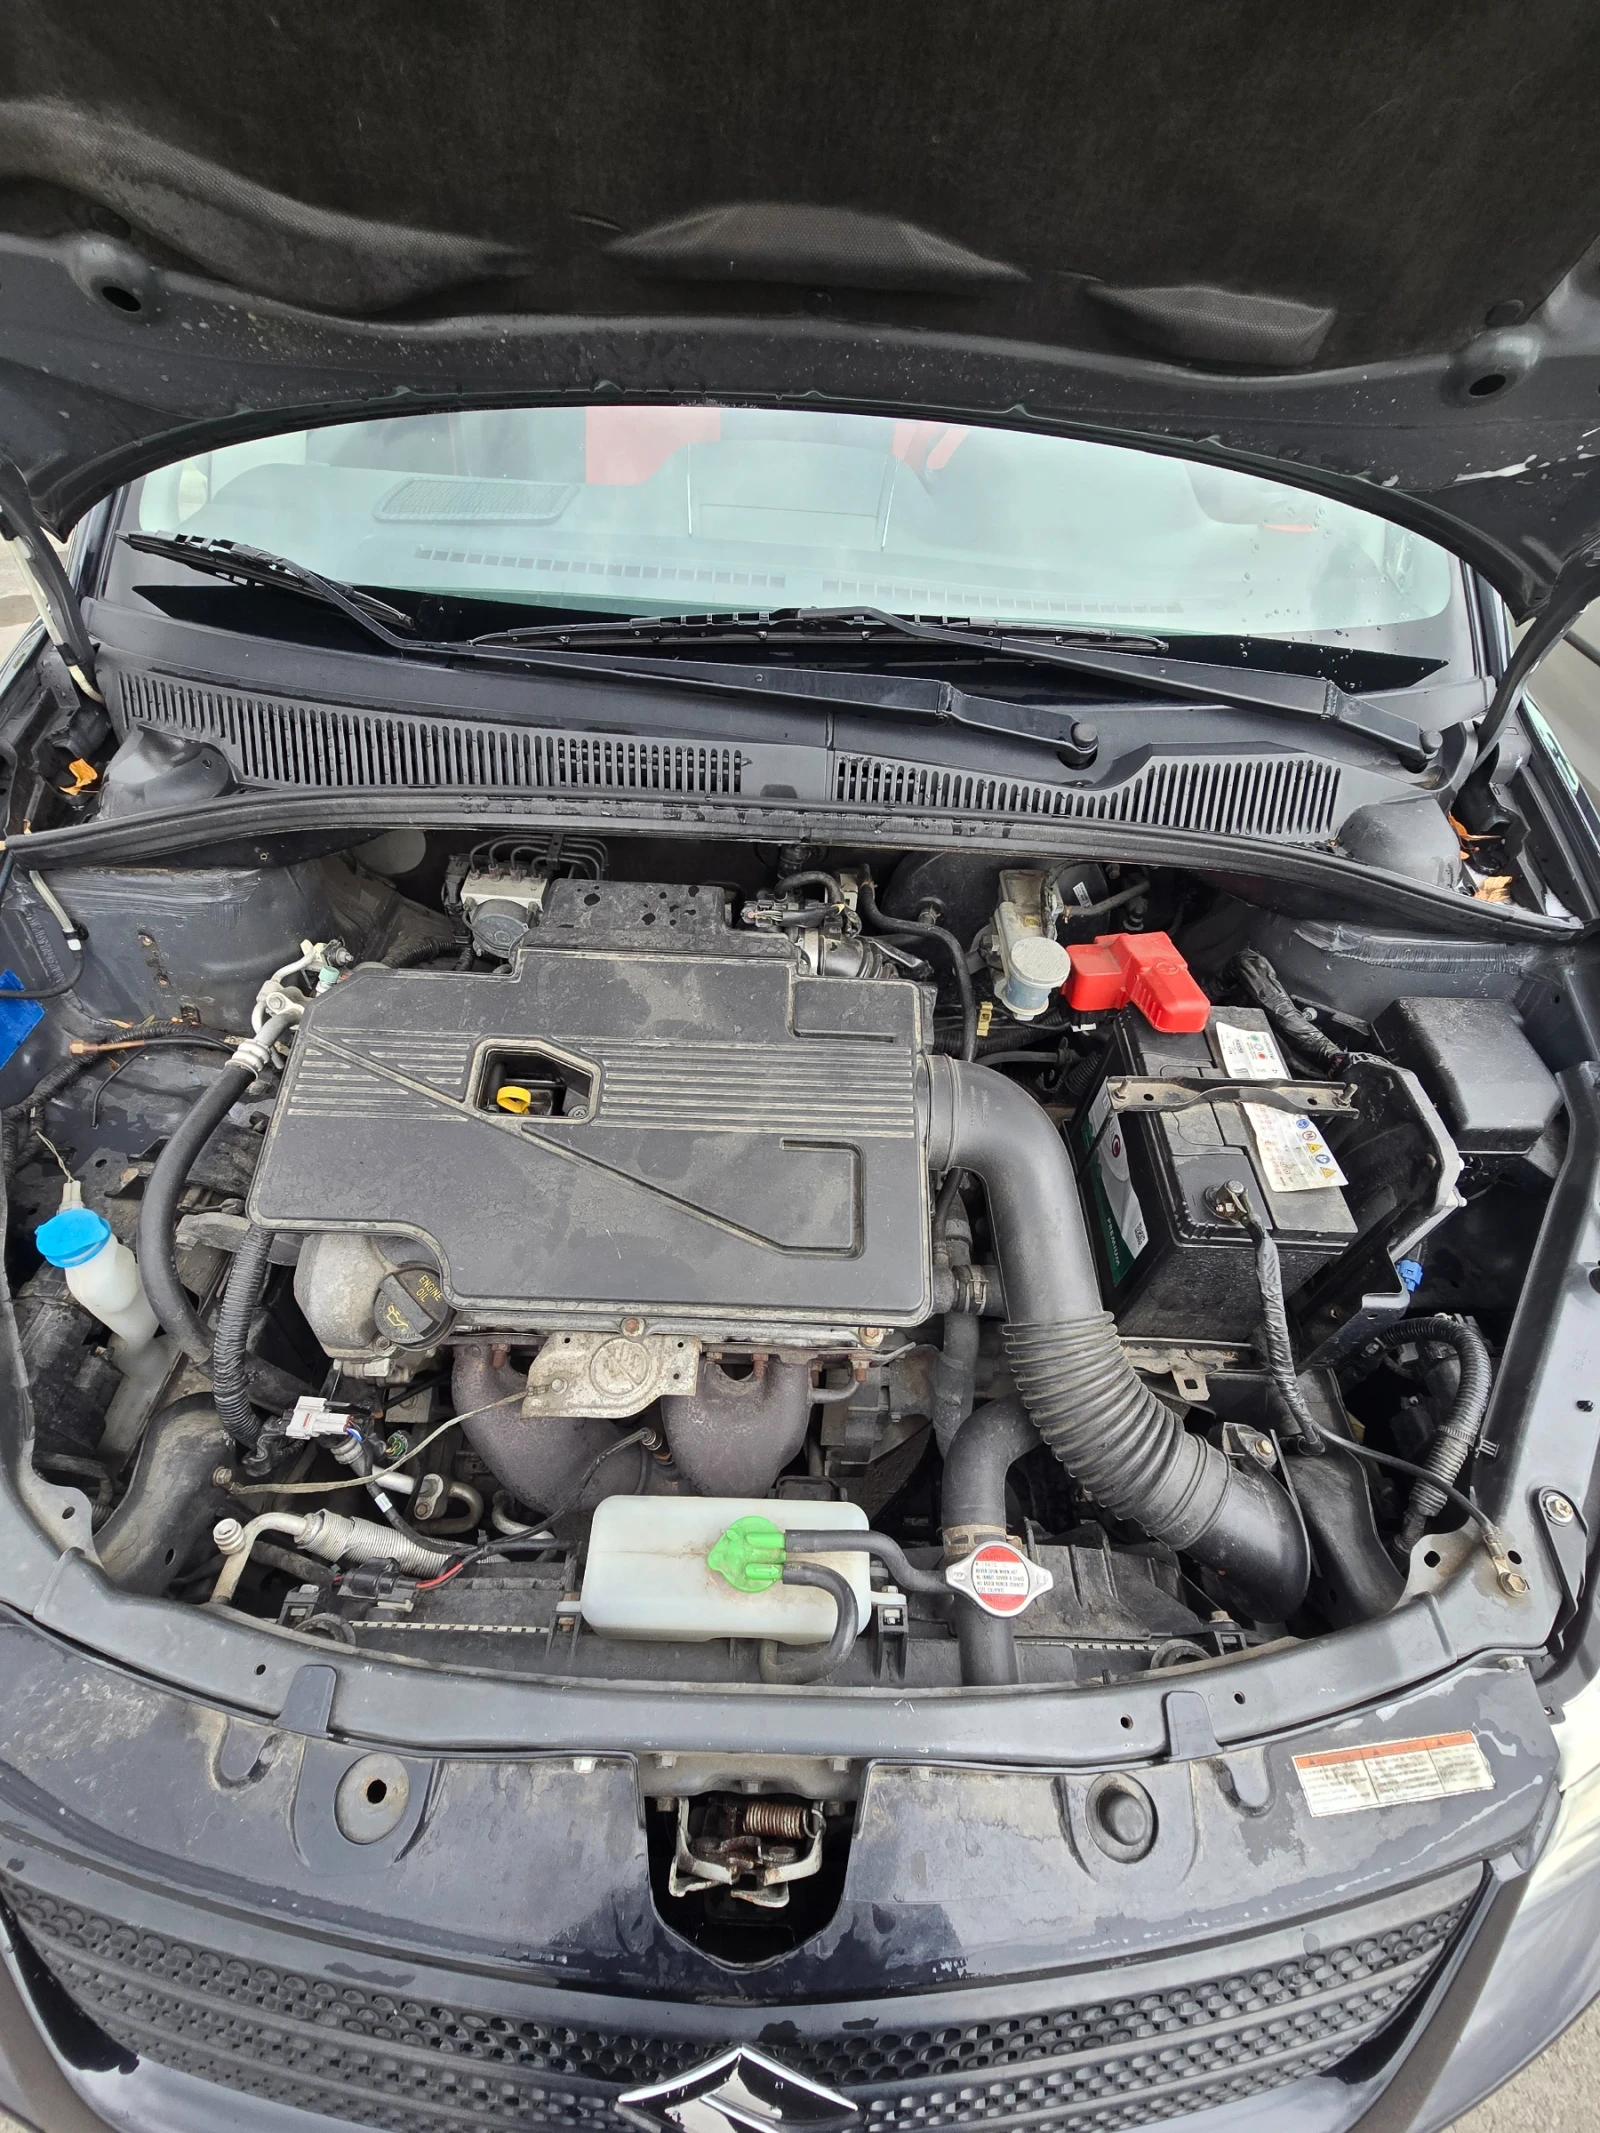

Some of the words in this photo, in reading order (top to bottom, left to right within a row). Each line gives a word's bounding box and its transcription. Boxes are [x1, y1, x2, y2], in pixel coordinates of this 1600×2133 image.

[1106, 1217, 1121, 1266] PREMIUM
[416, 1288, 428, 1303] OIL
[419, 1274, 443, 1302] ENGINE
